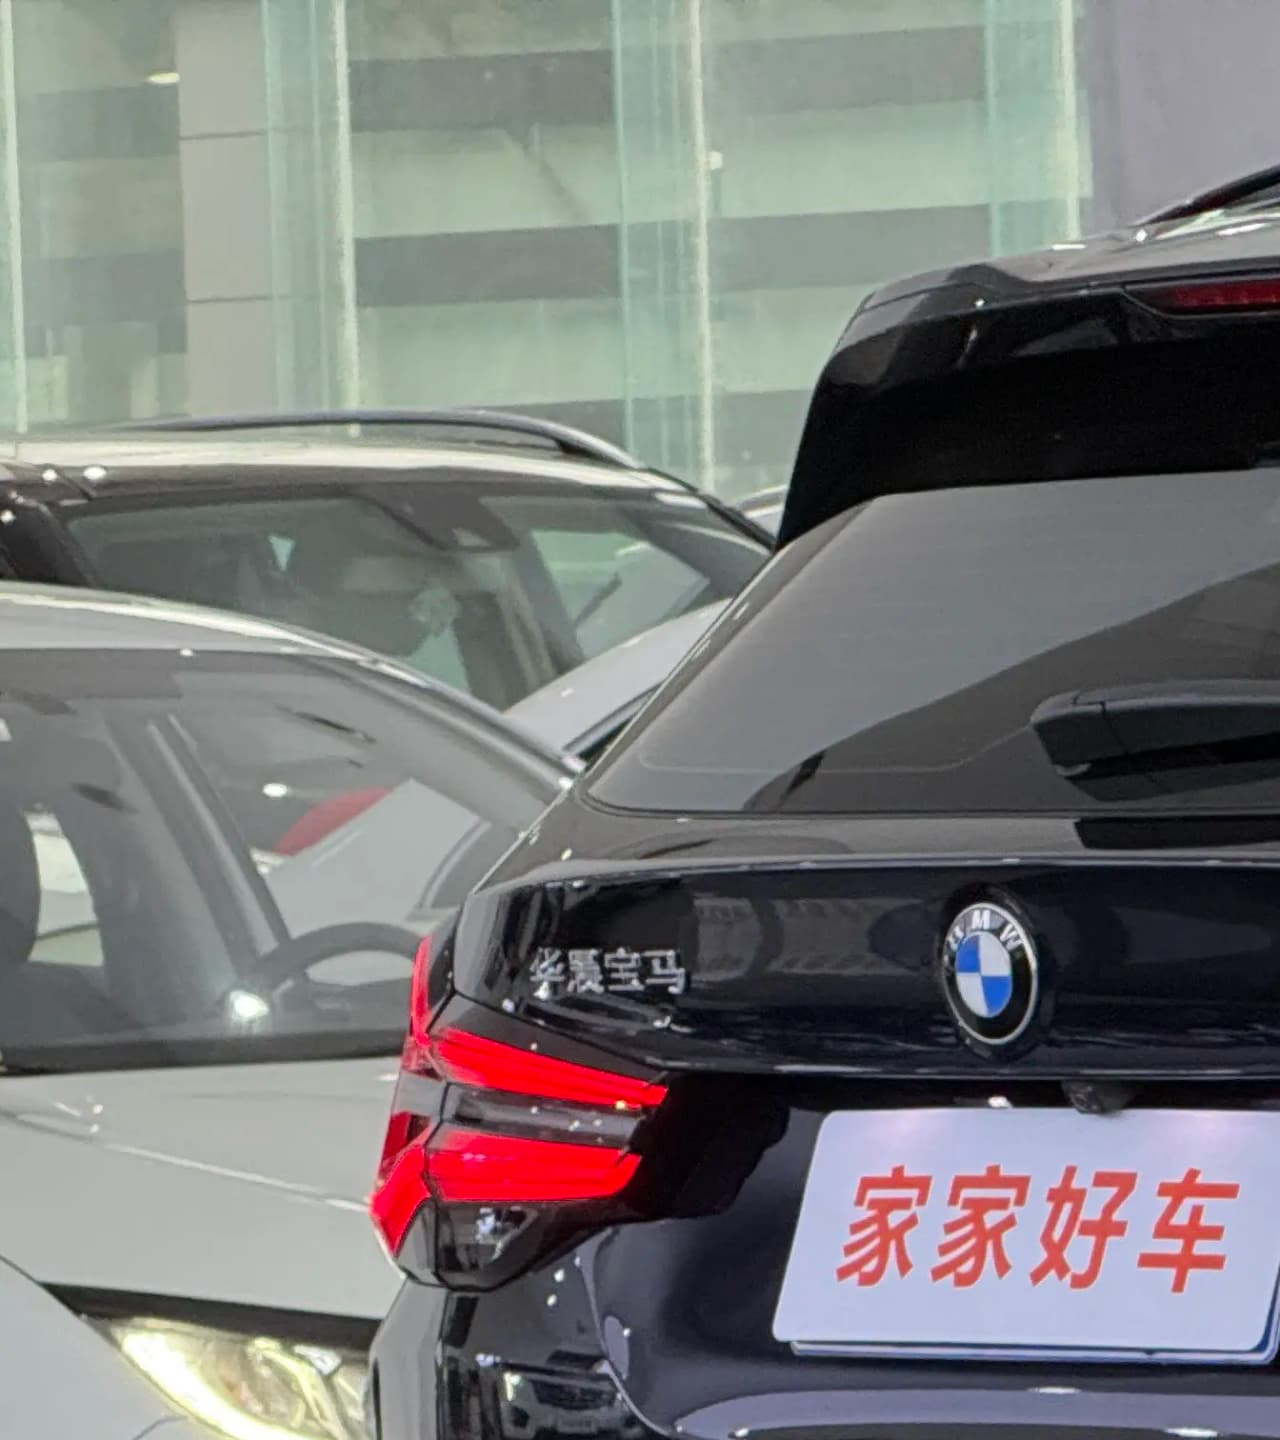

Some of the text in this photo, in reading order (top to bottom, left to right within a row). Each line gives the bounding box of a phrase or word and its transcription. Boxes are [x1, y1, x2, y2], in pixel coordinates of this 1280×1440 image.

[947, 908, 1024, 952] BMW
[835, 1164, 1240, 1294] 家家好车
